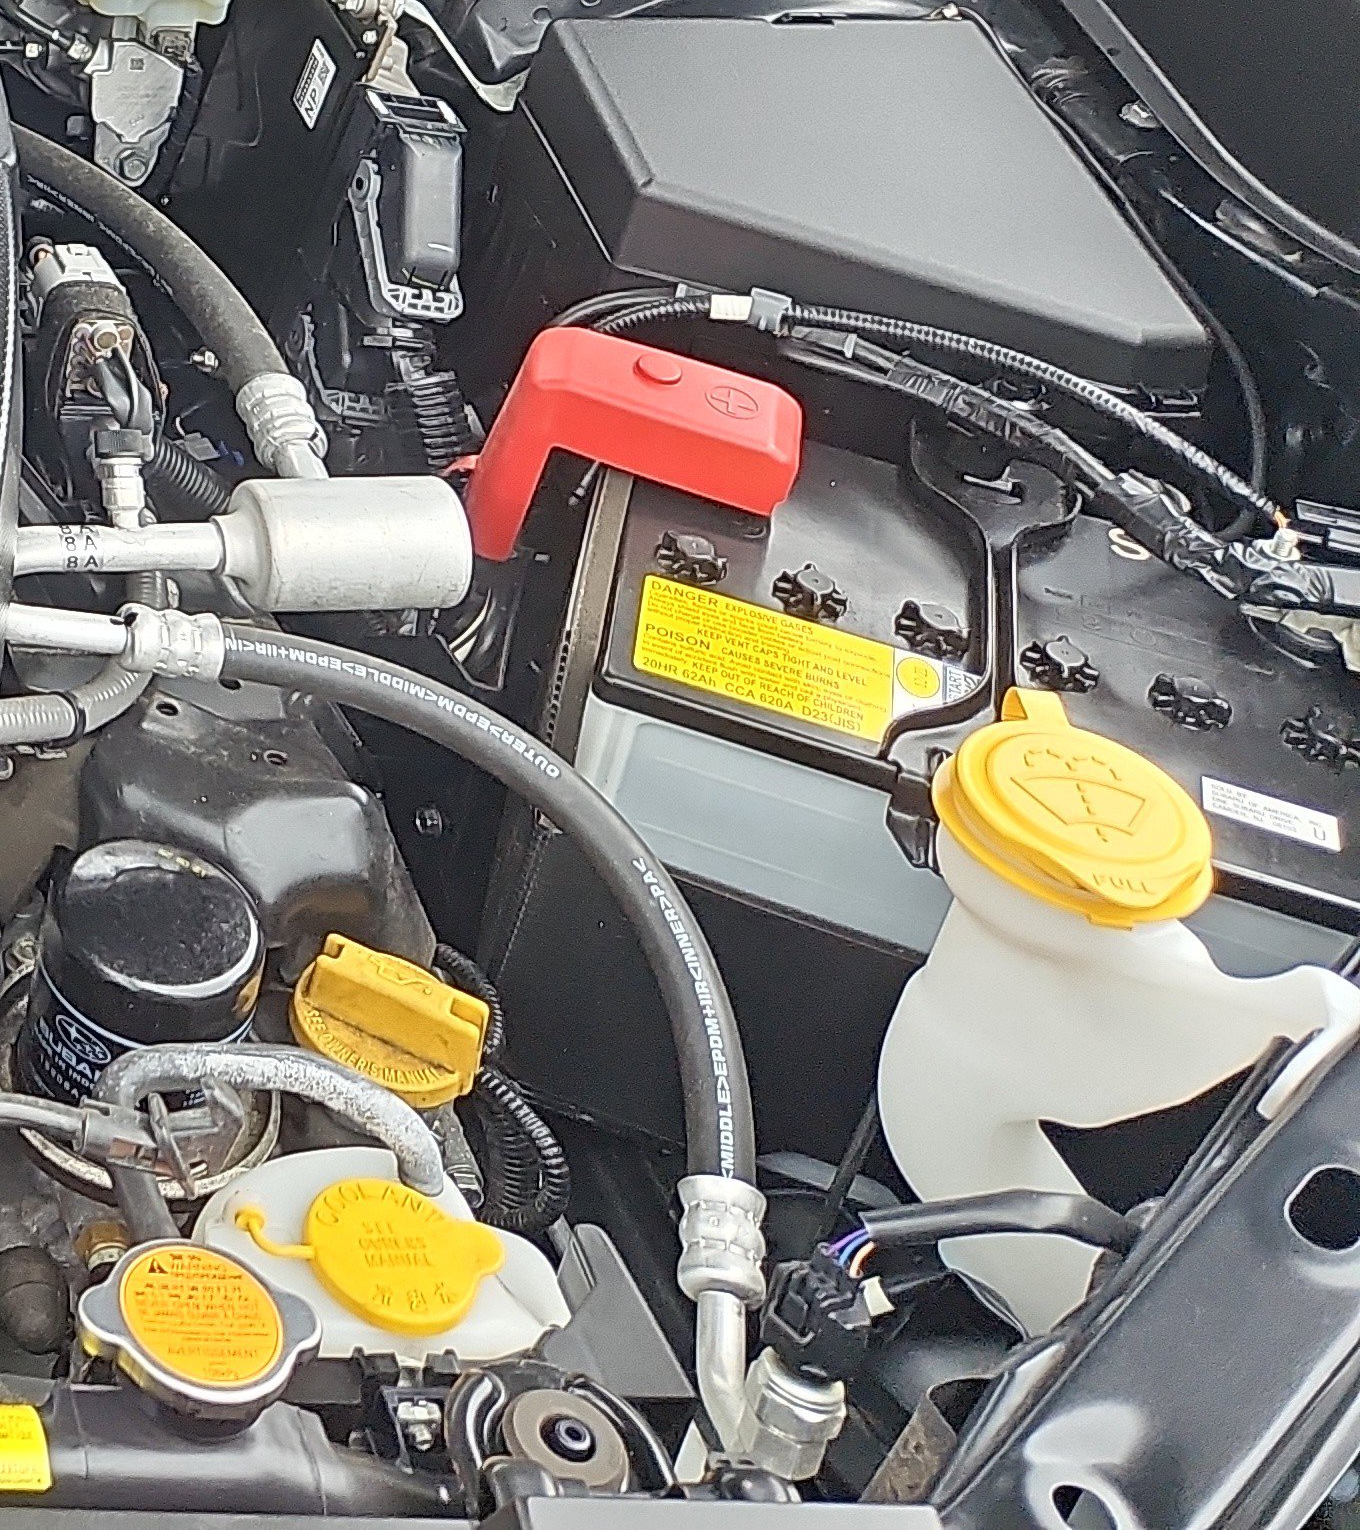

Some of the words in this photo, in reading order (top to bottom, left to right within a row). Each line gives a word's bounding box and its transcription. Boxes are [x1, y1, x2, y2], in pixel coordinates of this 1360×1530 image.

[1108, 528, 1151, 561] S
[651, 579, 718, 608] DANGER
[725, 602, 777, 624] EXPLOSIVE
[780, 618, 813, 635] GASES
[645, 622, 710, 650] POISON
[721, 646, 760, 664] CAUSES
[763, 659, 802, 677] SEVERE
[805, 672, 839, 689] BURNS
[697, 627, 722, 641] KEEP
[725, 635, 749, 650] VENT
[752, 644, 779, 659] CAPS
[782, 653, 810, 668] TIGHT
[812, 662, 833, 675] AND
[836, 670, 866, 686] LEVEL
[642, 656, 678, 675] 20HR
[681, 668, 716, 687] 62Ah
[724, 681, 756, 699] CCA
[759, 692, 794, 711] 620A
[801, 705, 861, 732] D23(JIS)
[692, 660, 717, 675] KEEP
[720, 669, 740, 682] OUT
[743, 676, 757, 687] OF
[759, 681, 794, 699] REACH
[796, 693, 810, 703] OF
[813, 698, 863, 720] CHILDREN
[1313, 826, 1326, 841] U
[1092, 873, 1156, 896] FULL
[305, 1006, 327, 1034] SEE
[318, 1032, 384, 1079] OWNER'S
[384, 1066, 443, 1085] MANUAL
[315, 1182, 446, 1227] COOLANT
